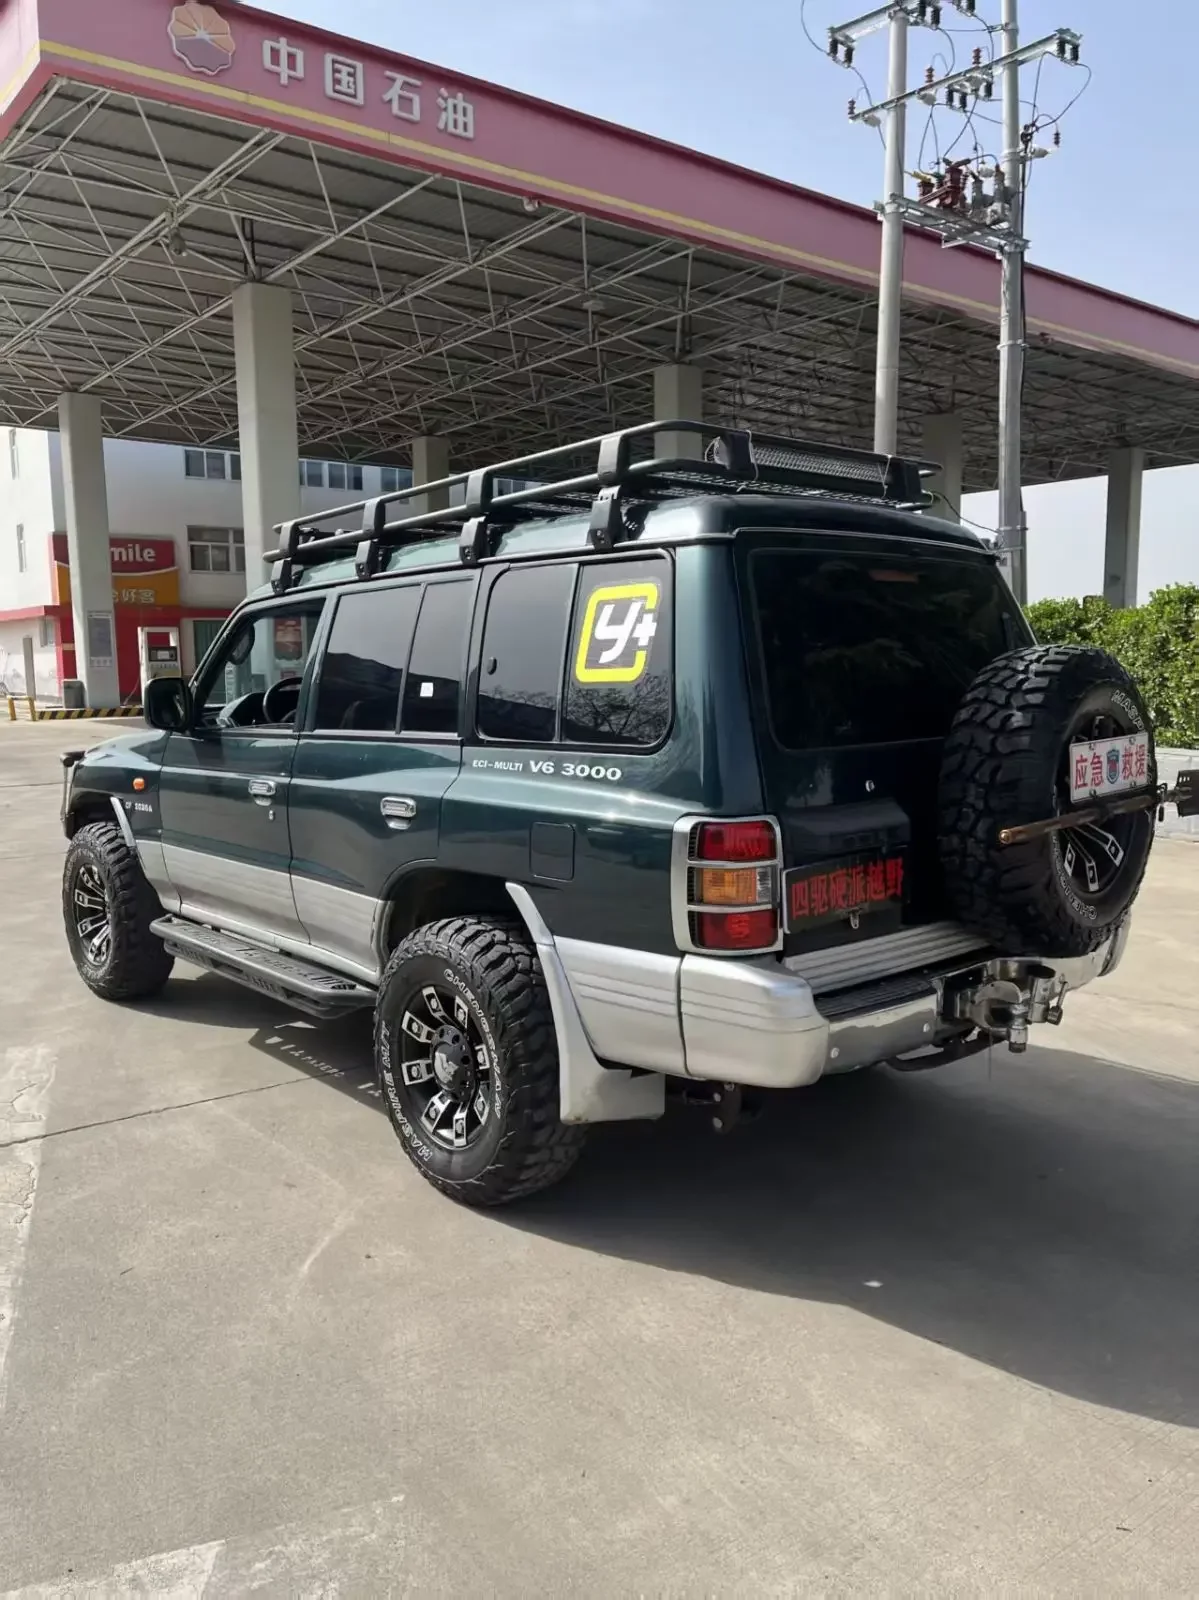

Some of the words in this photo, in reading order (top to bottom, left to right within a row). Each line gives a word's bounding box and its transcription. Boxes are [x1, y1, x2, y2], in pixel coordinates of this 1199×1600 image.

[262, 37, 475, 139] 中国石油
[472, 759, 523, 772] ECI-MULTI
[529, 760, 555, 774] V6
[561, 763, 622, 781] 3000
[1074, 752, 1104, 790] 应急
[1121, 743, 1146, 780] 救援
[791, 856, 904, 920] 四驱硬派越野
